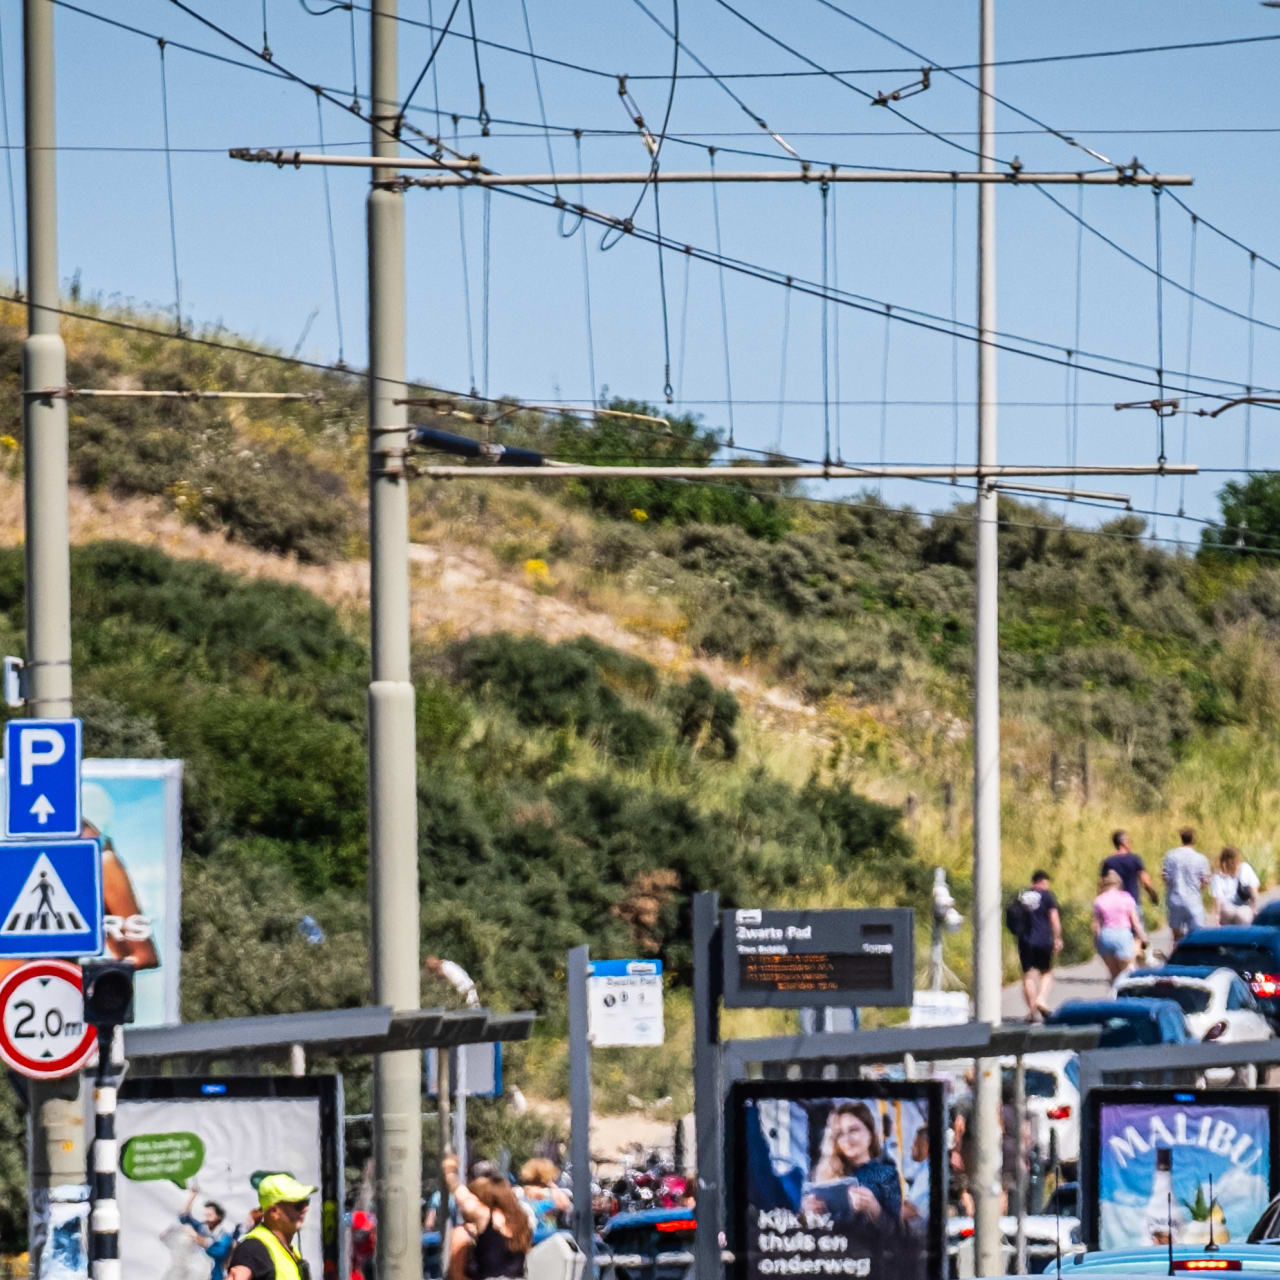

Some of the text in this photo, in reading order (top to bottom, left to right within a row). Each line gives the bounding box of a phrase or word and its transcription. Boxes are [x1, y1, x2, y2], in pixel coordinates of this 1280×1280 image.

[20, 729, 65, 785] P
[103, 914, 153, 941] RS
[1108, 1112, 1263, 1169] MALIBU
[758, 1231, 849, 1253] thuis en
[758, 1255, 871, 1277] onderweg
